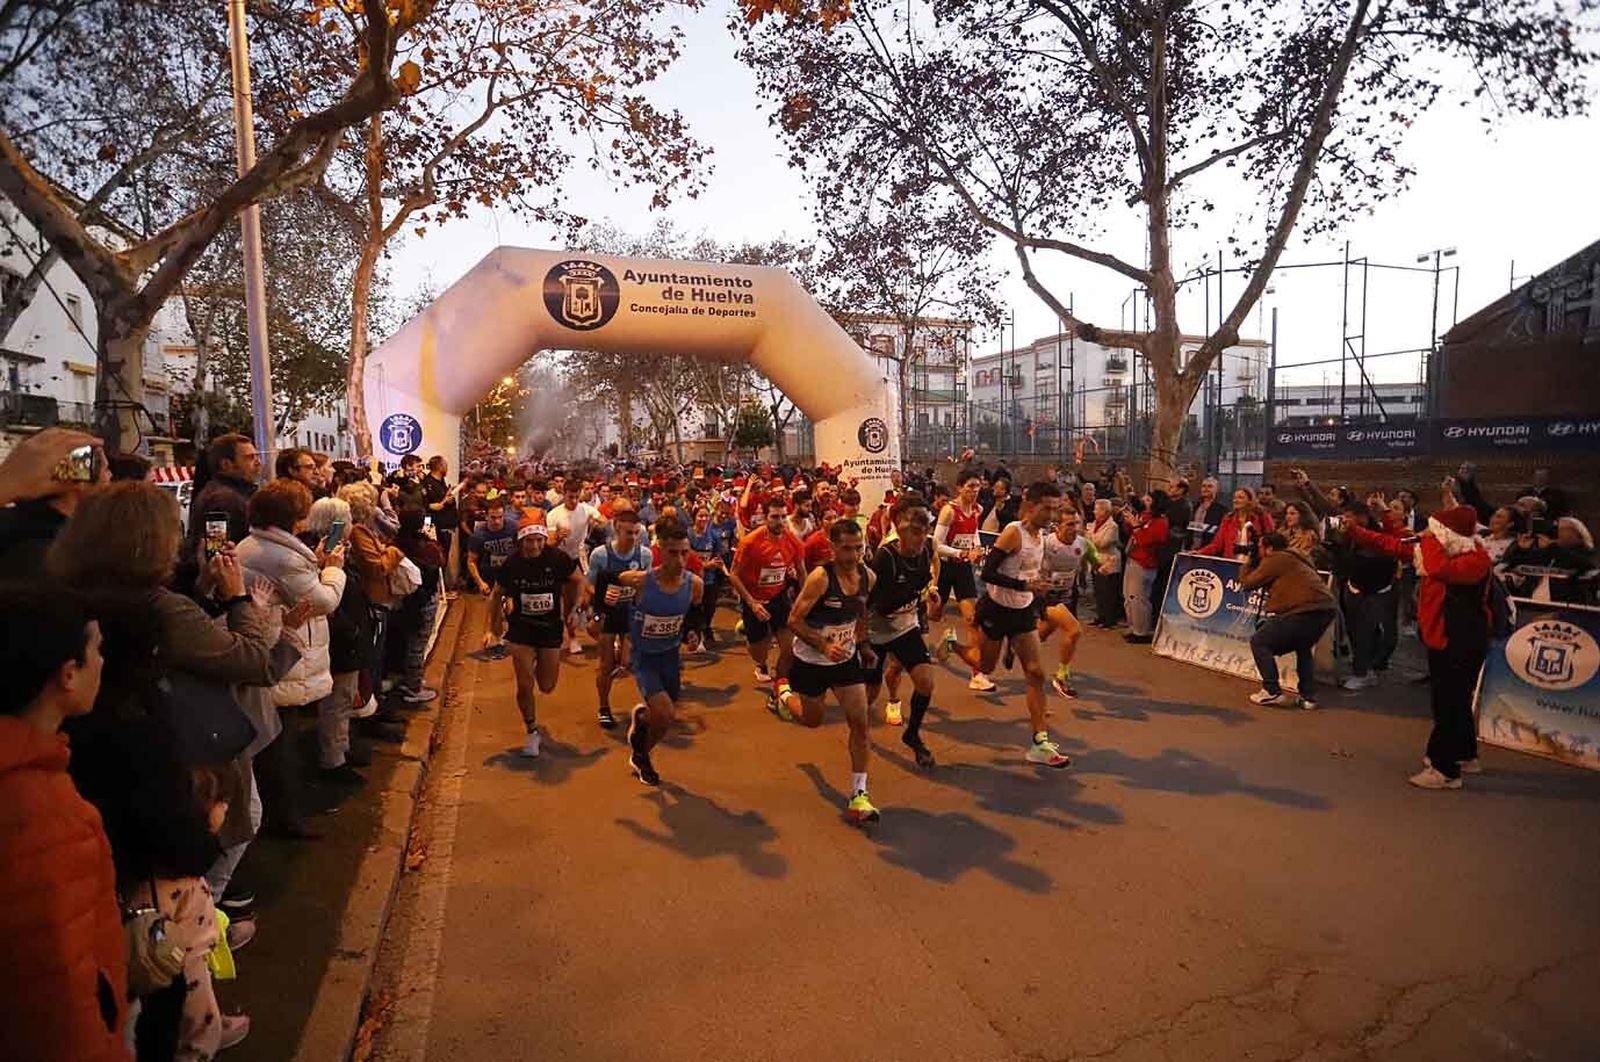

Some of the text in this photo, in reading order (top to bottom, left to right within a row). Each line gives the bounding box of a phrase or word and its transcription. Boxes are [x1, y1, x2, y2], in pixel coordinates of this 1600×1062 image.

[623, 269, 753, 289] Ayuntamiento
[661, 286, 753, 305] de Huelva
[691, 306, 705, 316] de
[708, 307, 756, 319] Deportes
[1366, 429, 1416, 440] HYUNDAI
[1467, 426, 1530, 436] HYUNDAI
[1294, 432, 1336, 442] HYUNDAI
[861, 466, 873, 474] de
